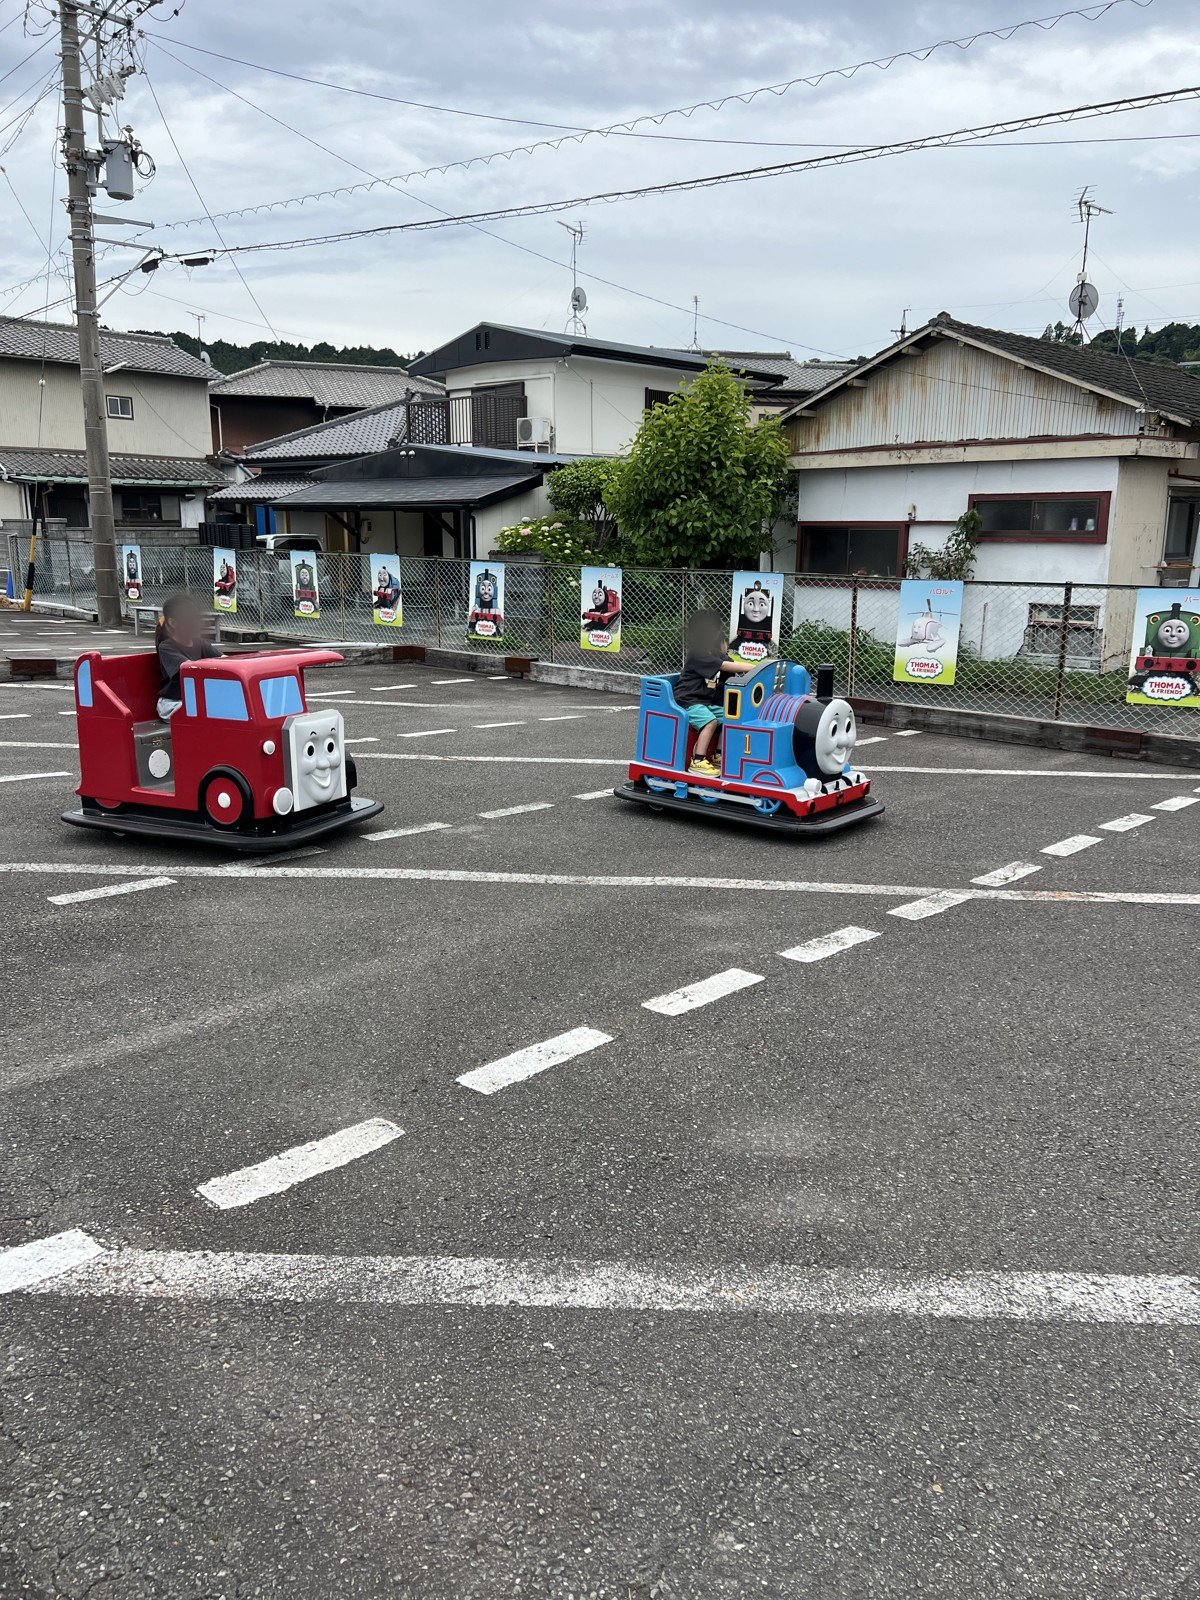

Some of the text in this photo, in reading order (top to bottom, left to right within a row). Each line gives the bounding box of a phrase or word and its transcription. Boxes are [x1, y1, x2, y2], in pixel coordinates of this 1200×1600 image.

[741, 645, 765, 653] THOMAS
[910, 661, 939, 669] THOMAS
[1149, 681, 1186, 690] THOMAS
[744, 734, 752, 755] 1
